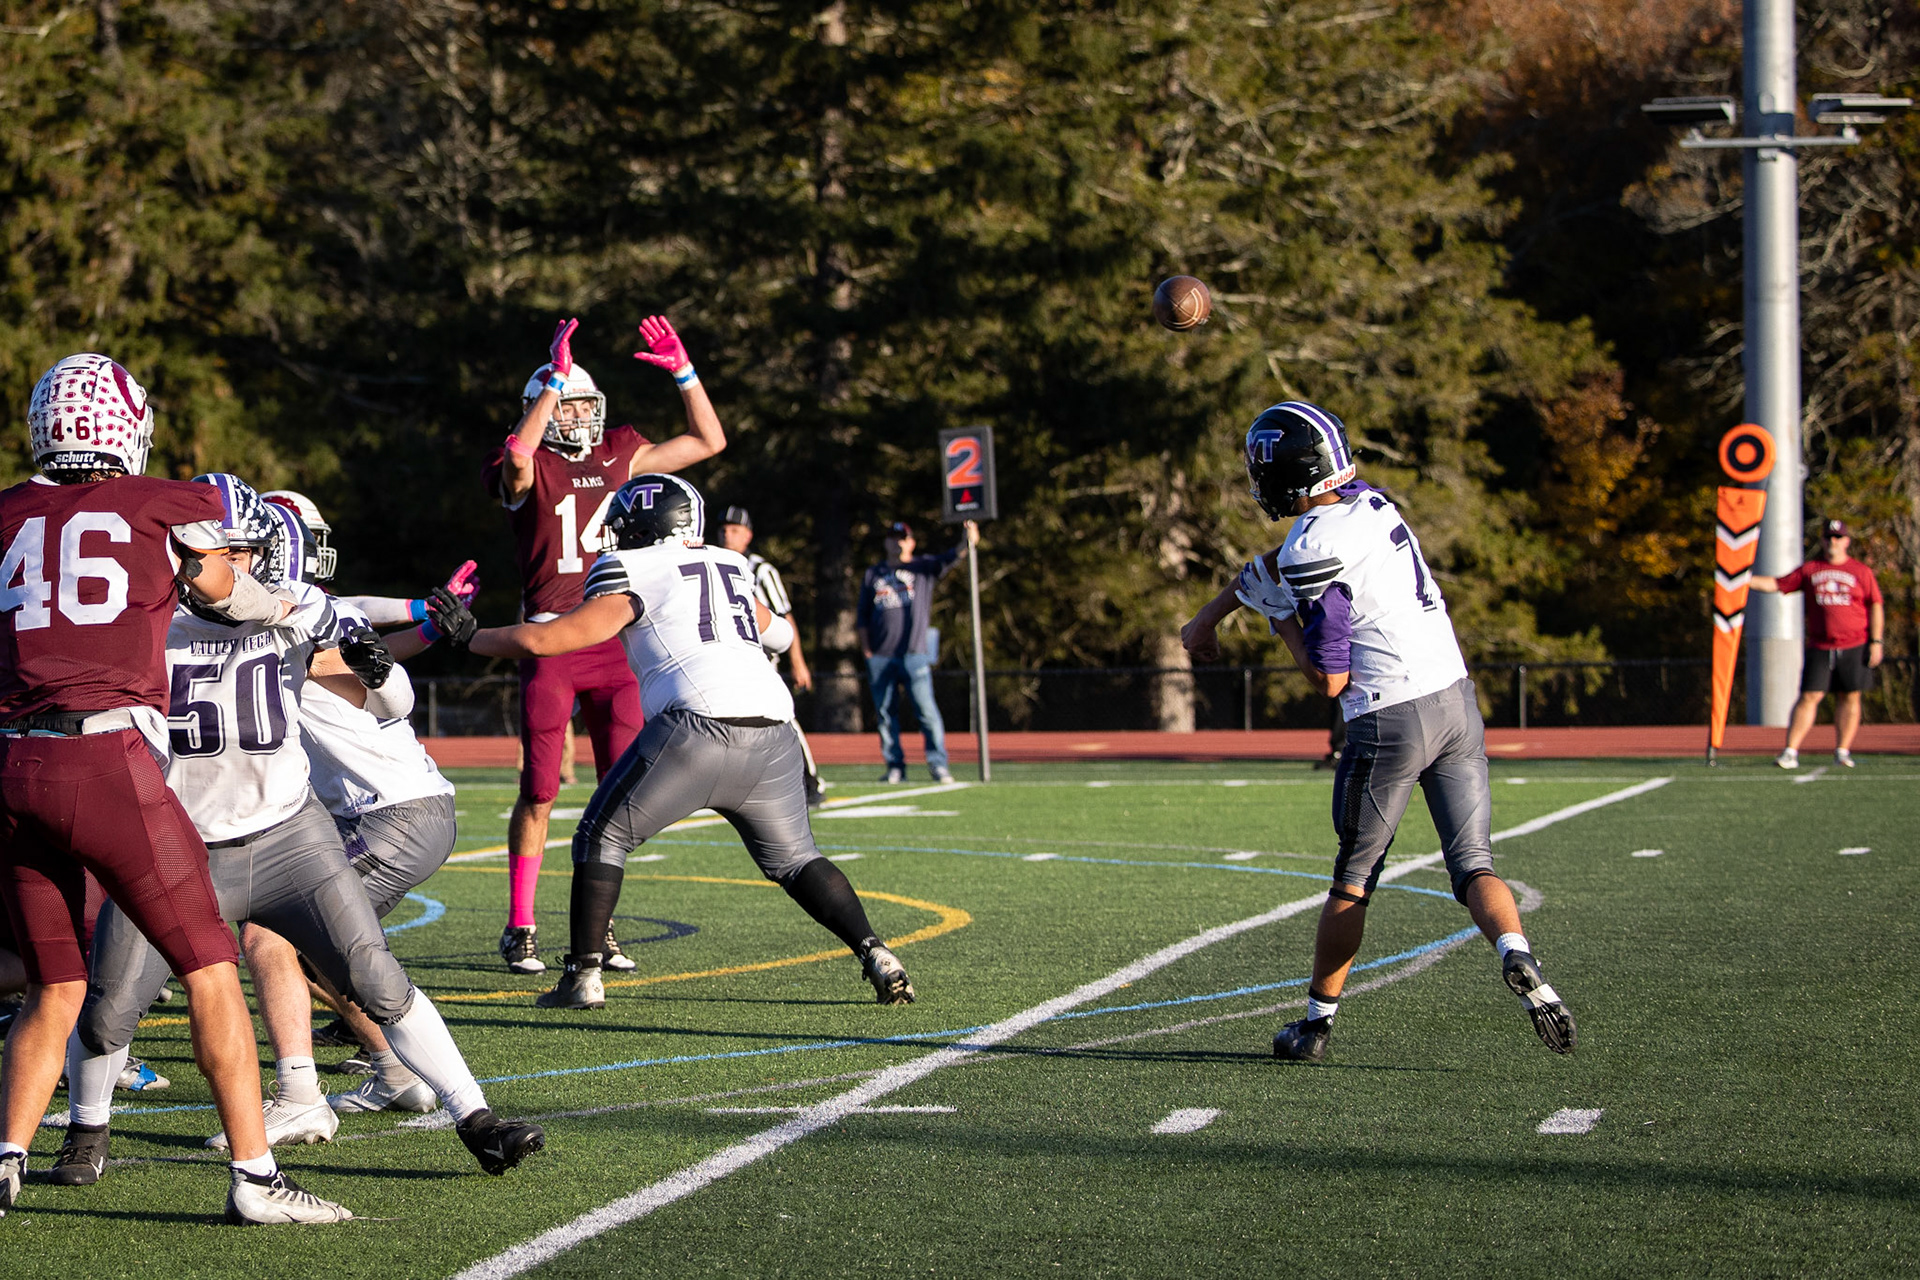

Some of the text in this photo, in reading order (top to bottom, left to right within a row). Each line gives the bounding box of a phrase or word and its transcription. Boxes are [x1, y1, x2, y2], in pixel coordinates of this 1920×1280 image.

[55, 451, 96, 463] schutt
[572, 476, 605, 489] RAMS
[946, 436, 983, 489] 2
[617, 483, 664, 513] VT
[554, 490, 619, 574] 14
[1302, 515, 1320, 535] 7
[0, 511, 131, 631] 46
[1389, 523, 1437, 612] 7
[678, 561, 763, 649] 75
[190, 630, 274, 657] VALLEY TECH
[168, 653, 289, 760] 50
